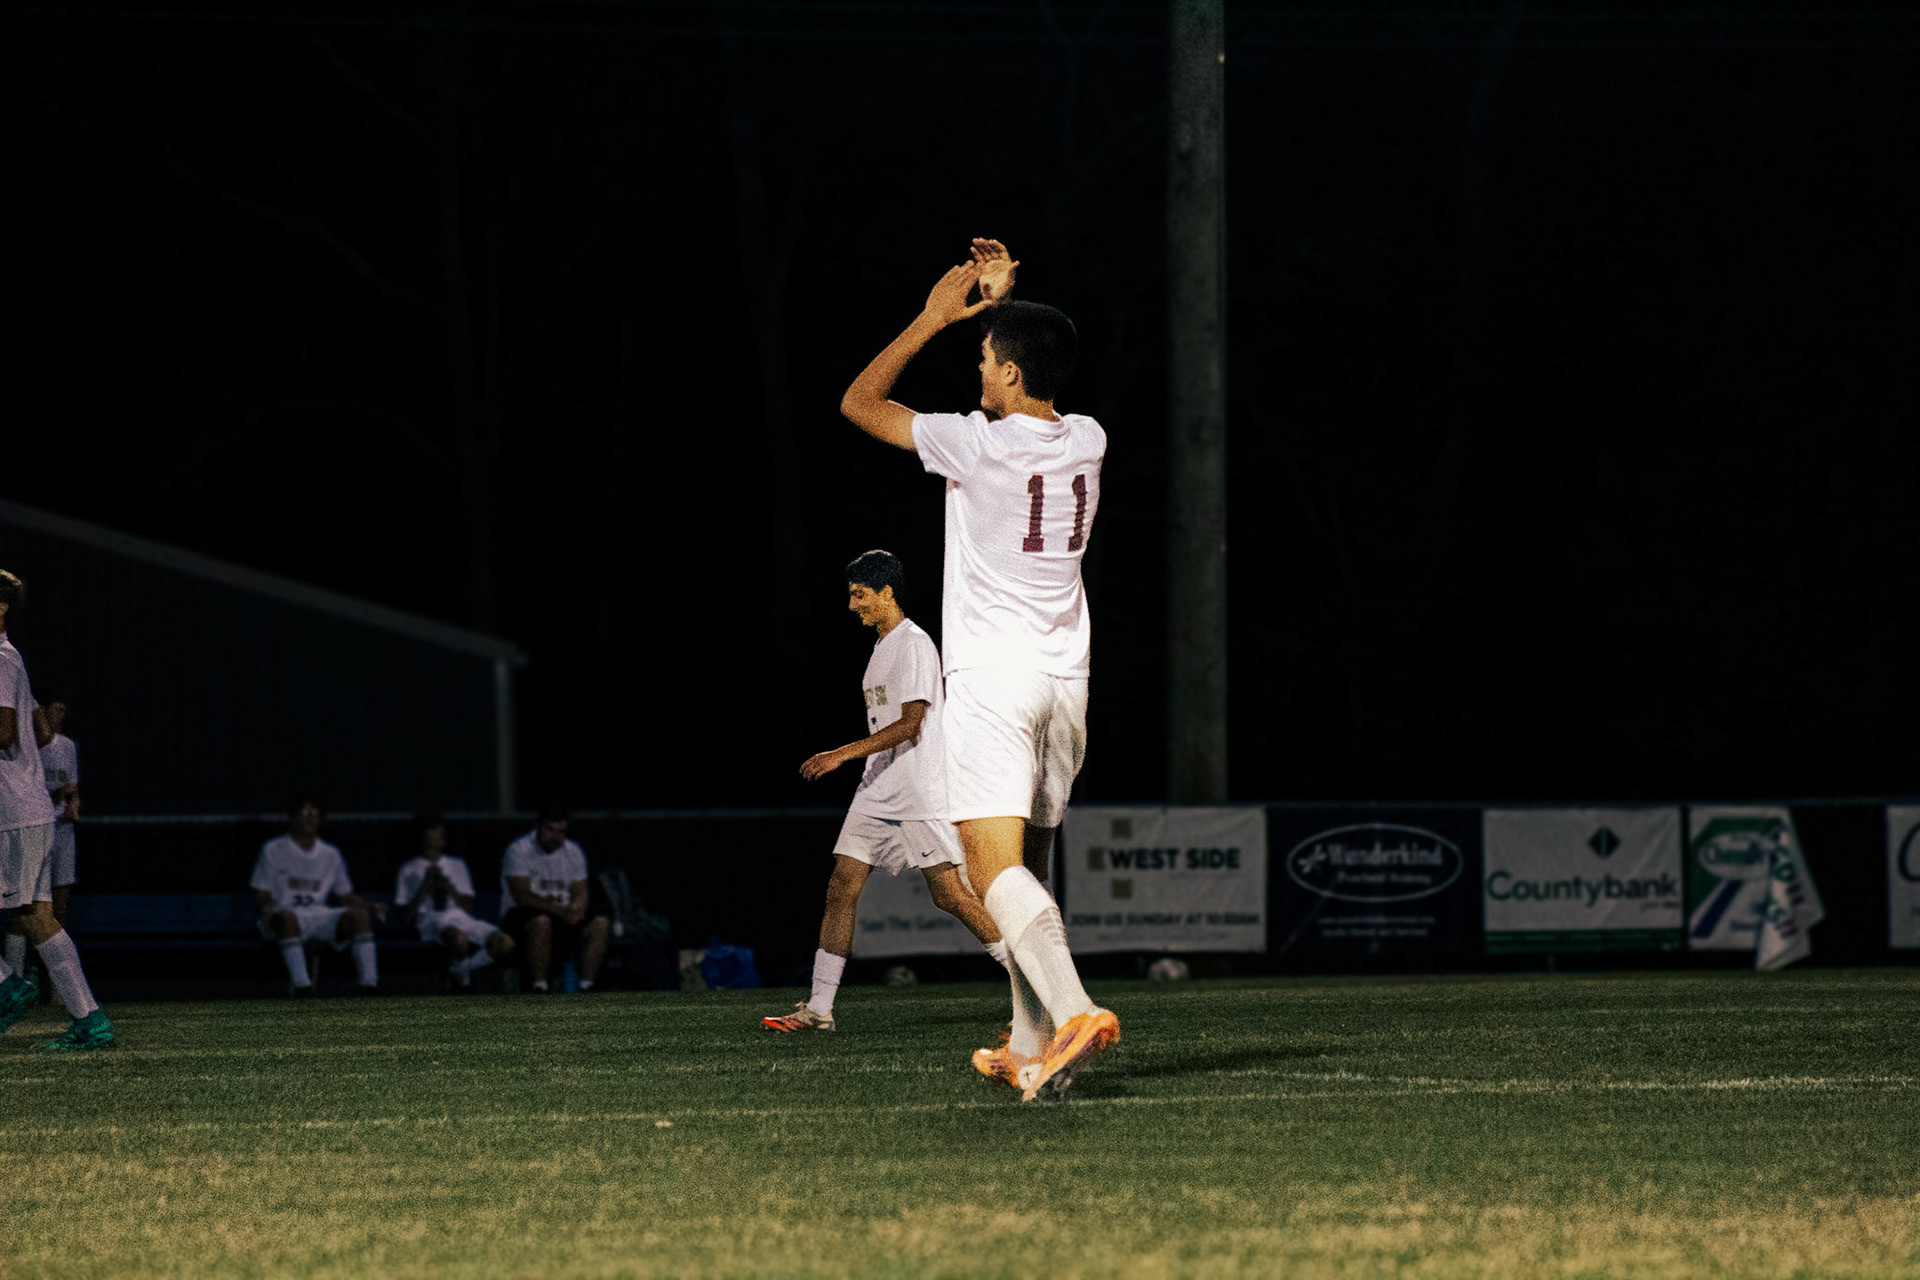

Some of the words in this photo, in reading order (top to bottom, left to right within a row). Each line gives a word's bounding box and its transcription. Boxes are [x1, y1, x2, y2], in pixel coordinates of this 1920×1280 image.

[1022, 473, 1086, 552] 11
[1110, 847, 1179, 870] WEST
[1186, 847, 1240, 870] SIDE
[1487, 870, 1677, 908] Countybank
